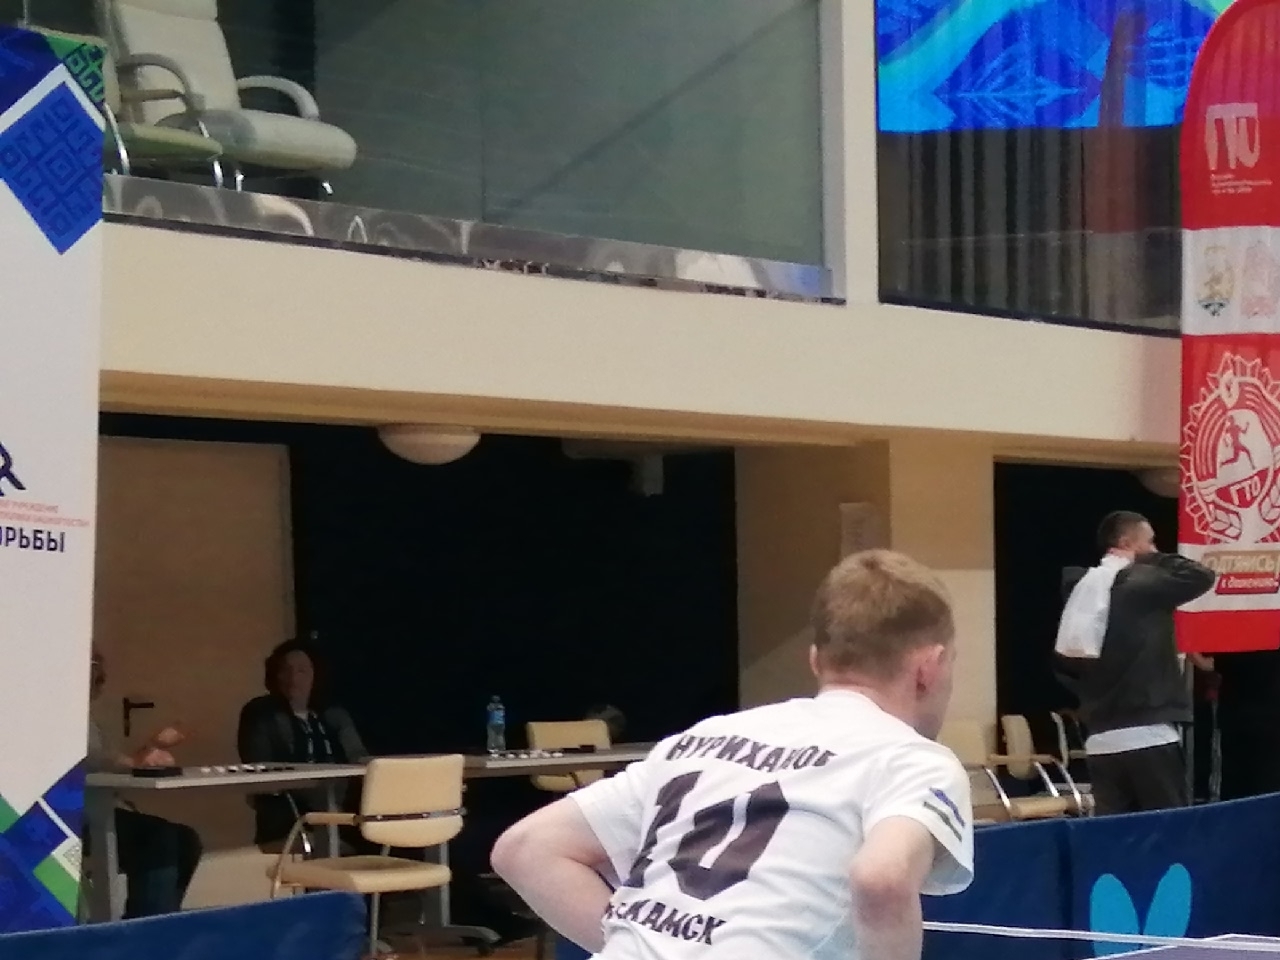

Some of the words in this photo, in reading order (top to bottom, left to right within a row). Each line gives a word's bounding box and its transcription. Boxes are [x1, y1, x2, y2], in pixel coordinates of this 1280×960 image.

[1230, 476, 1260, 506] ГТО
[0, 526, 66, 553] РЬБЫ
[623, 770, 789, 900] 10
